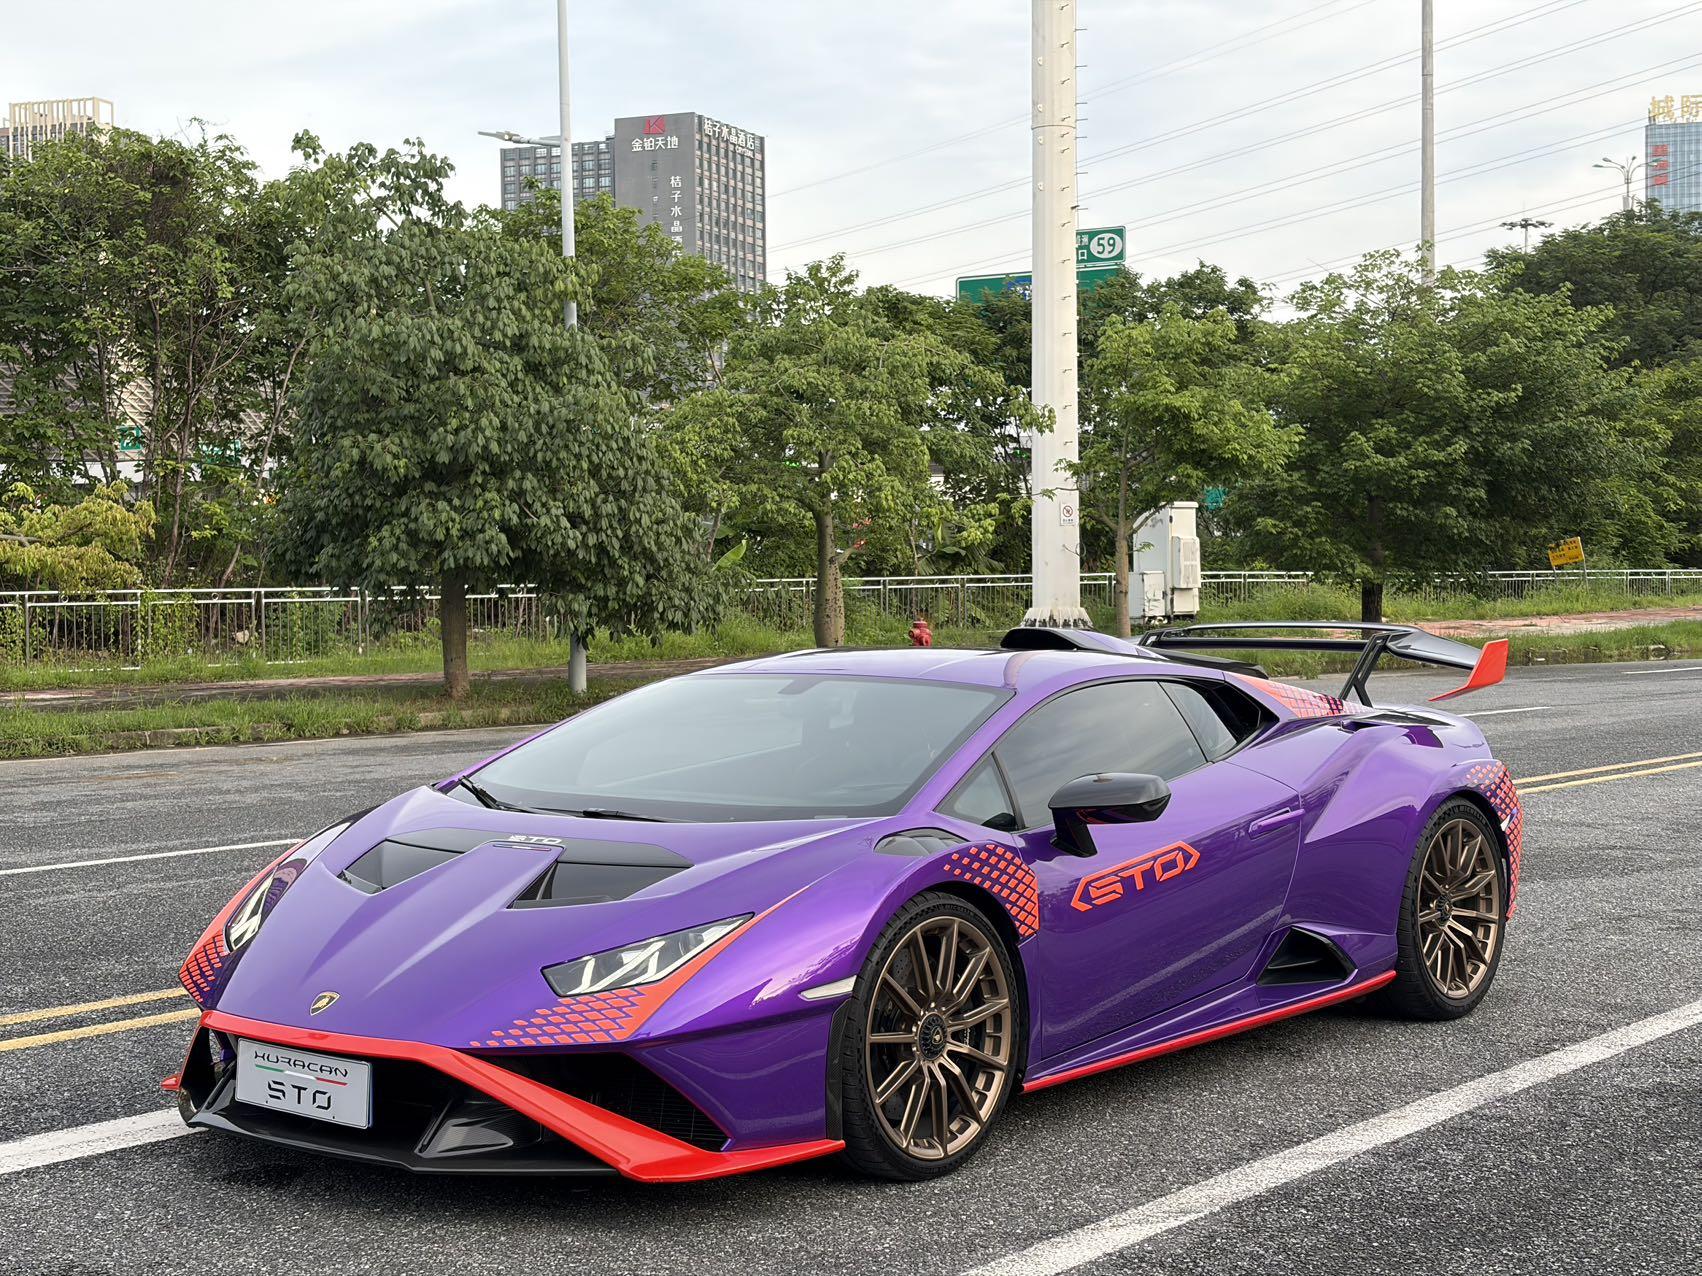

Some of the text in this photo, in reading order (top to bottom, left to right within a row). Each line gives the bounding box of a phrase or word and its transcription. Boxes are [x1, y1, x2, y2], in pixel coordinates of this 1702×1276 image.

[631, 135, 679, 152] 金铂天地
[704, 118, 755, 150] 桔子水晶酒店
[1096, 236, 1116, 255] 59
[1088, 849, 1186, 906] STO
[267, 1079, 332, 1111] STO
